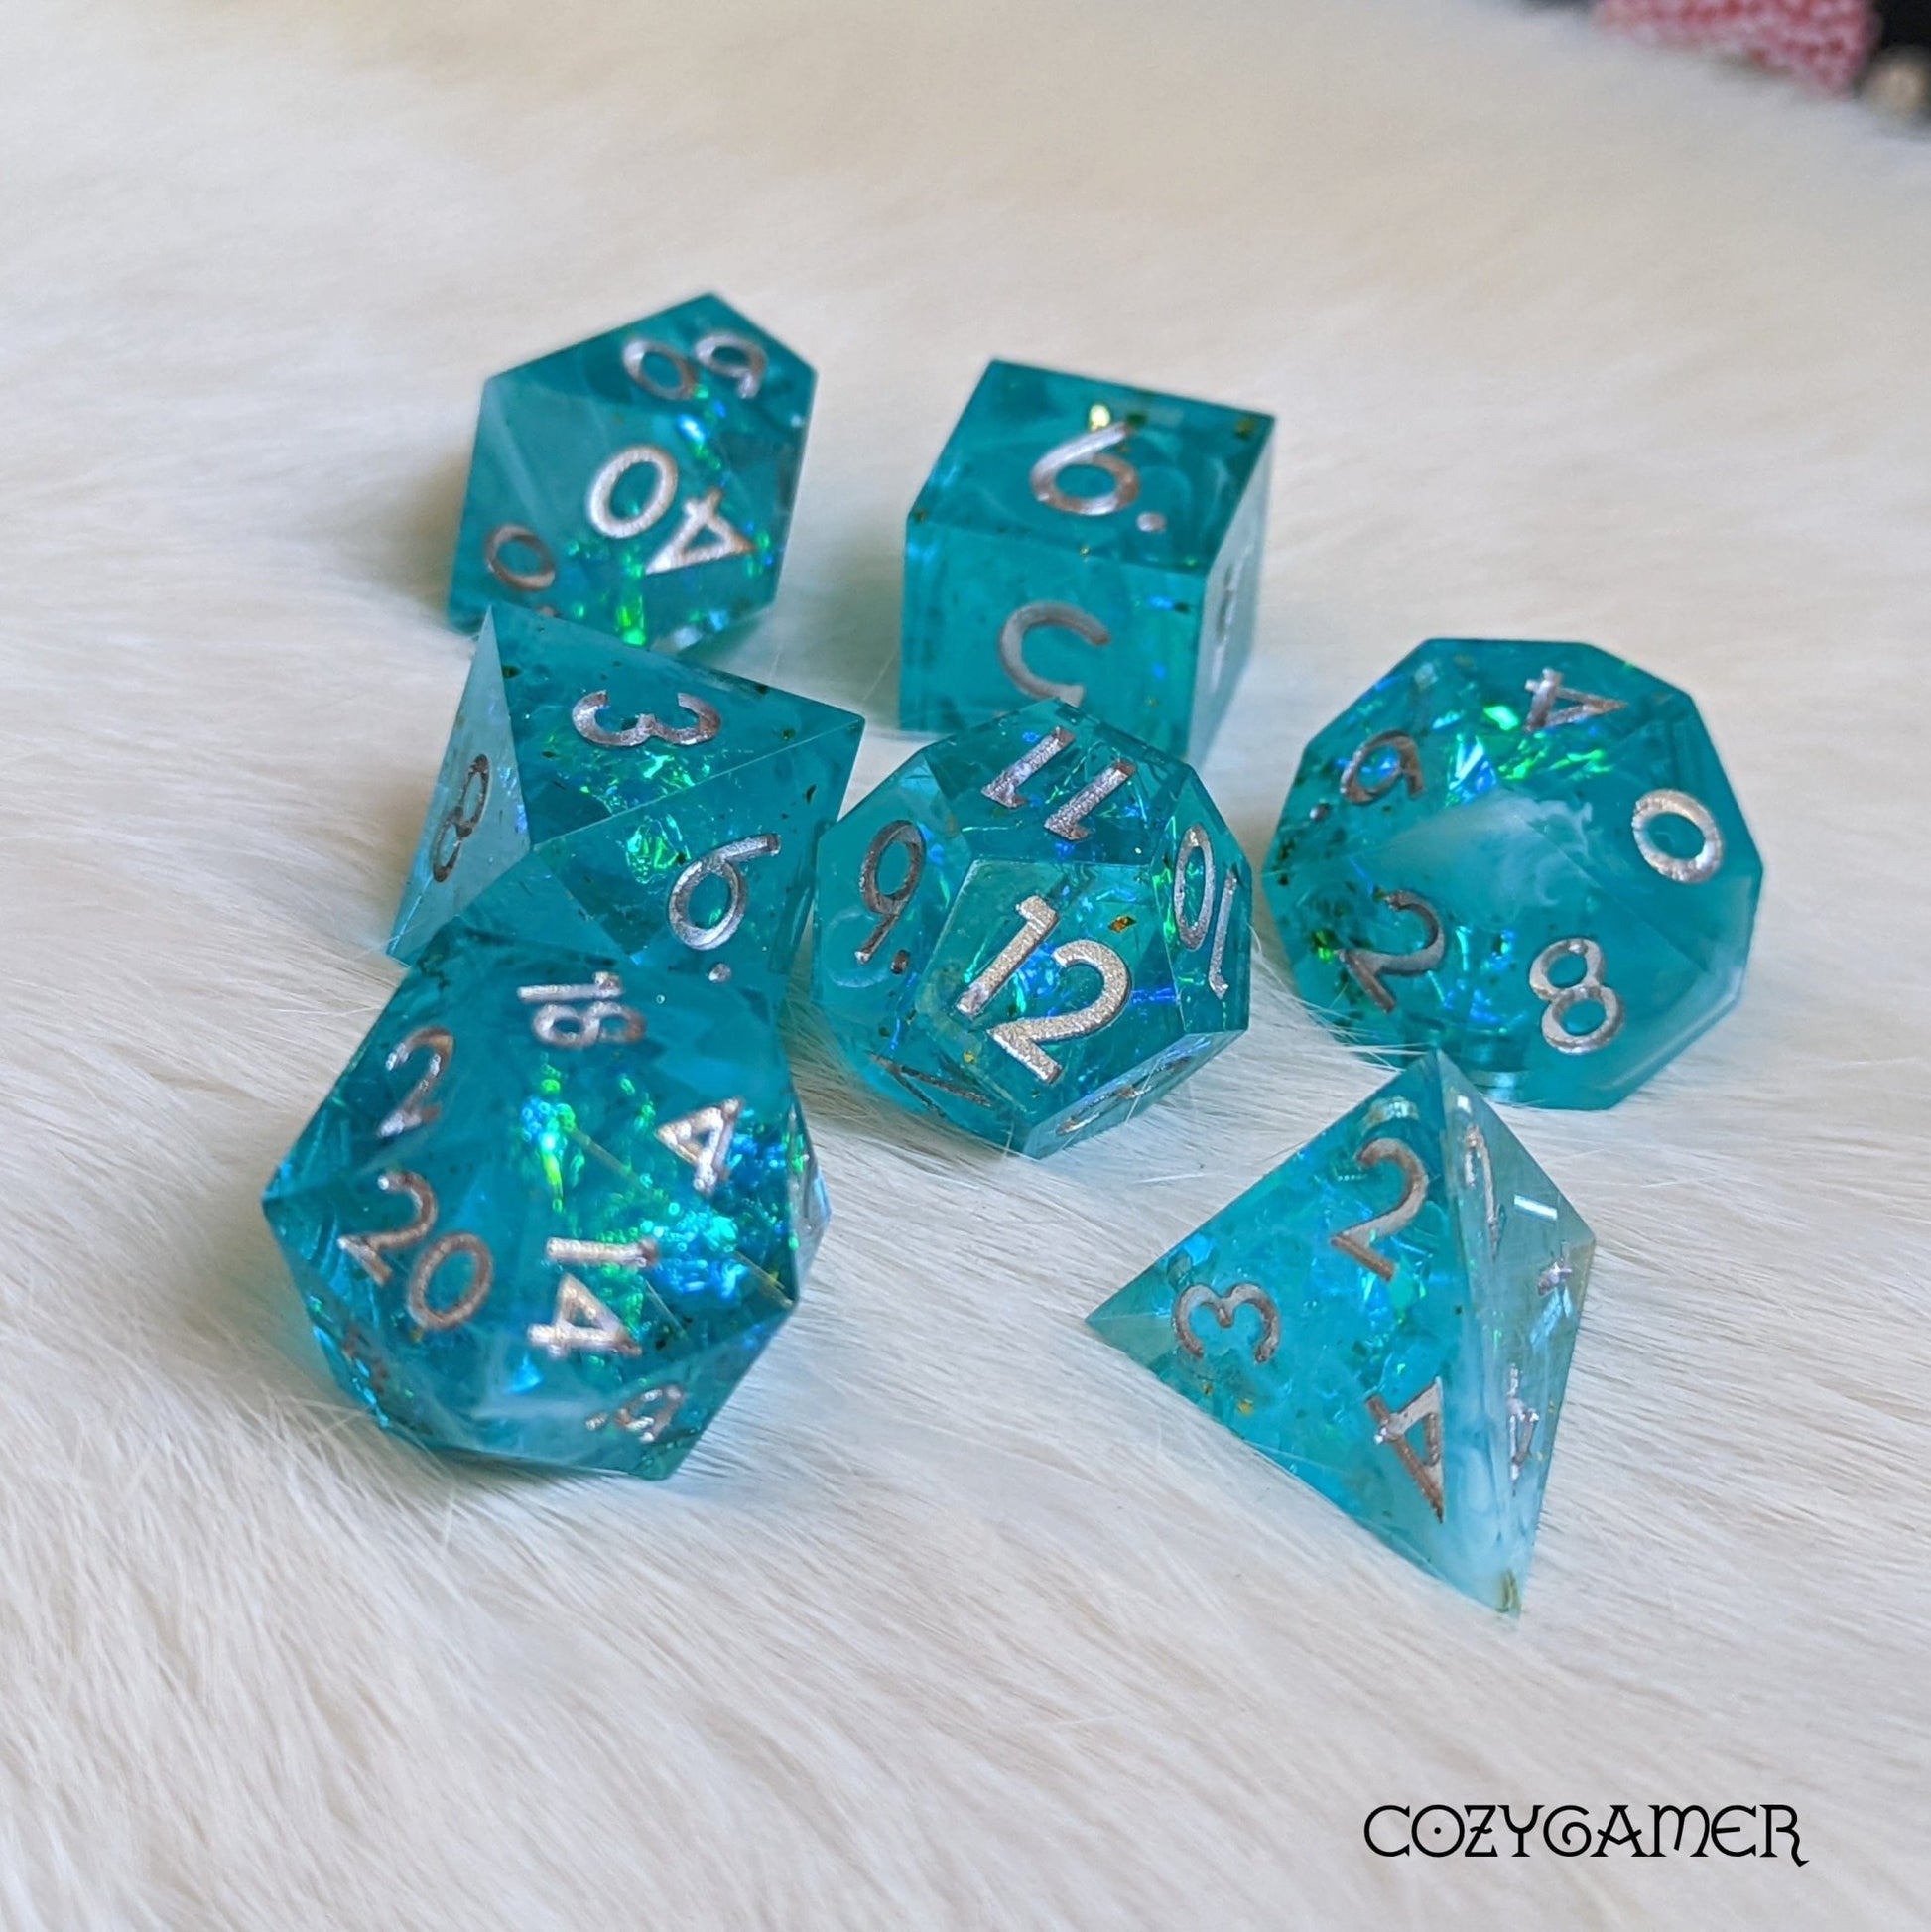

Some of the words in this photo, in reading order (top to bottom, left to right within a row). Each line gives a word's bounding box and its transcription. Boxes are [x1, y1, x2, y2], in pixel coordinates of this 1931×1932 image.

[572, 690, 722, 748] 3
[1524, 667, 1628, 732] 4
[431, 753, 489, 882] 8
[980, 725, 1137, 841] 11
[1631, 788, 1724, 884] 0
[517, 971, 647, 1050] 18
[955, 895, 1129, 1085] 12
[1334, 889, 1446, 1015] 2
[1529, 937, 1626, 1056] 8
[375, 1025, 454, 1138] 2
[654, 1097, 746, 1198] 4
[337, 1170, 494, 1331] 20
[1330, 1137, 1429, 1283] 2
[527, 1237, 660, 1359] 14
[1173, 1283, 1282, 1365] 3
[1364, 1376, 1445, 1525] 4
